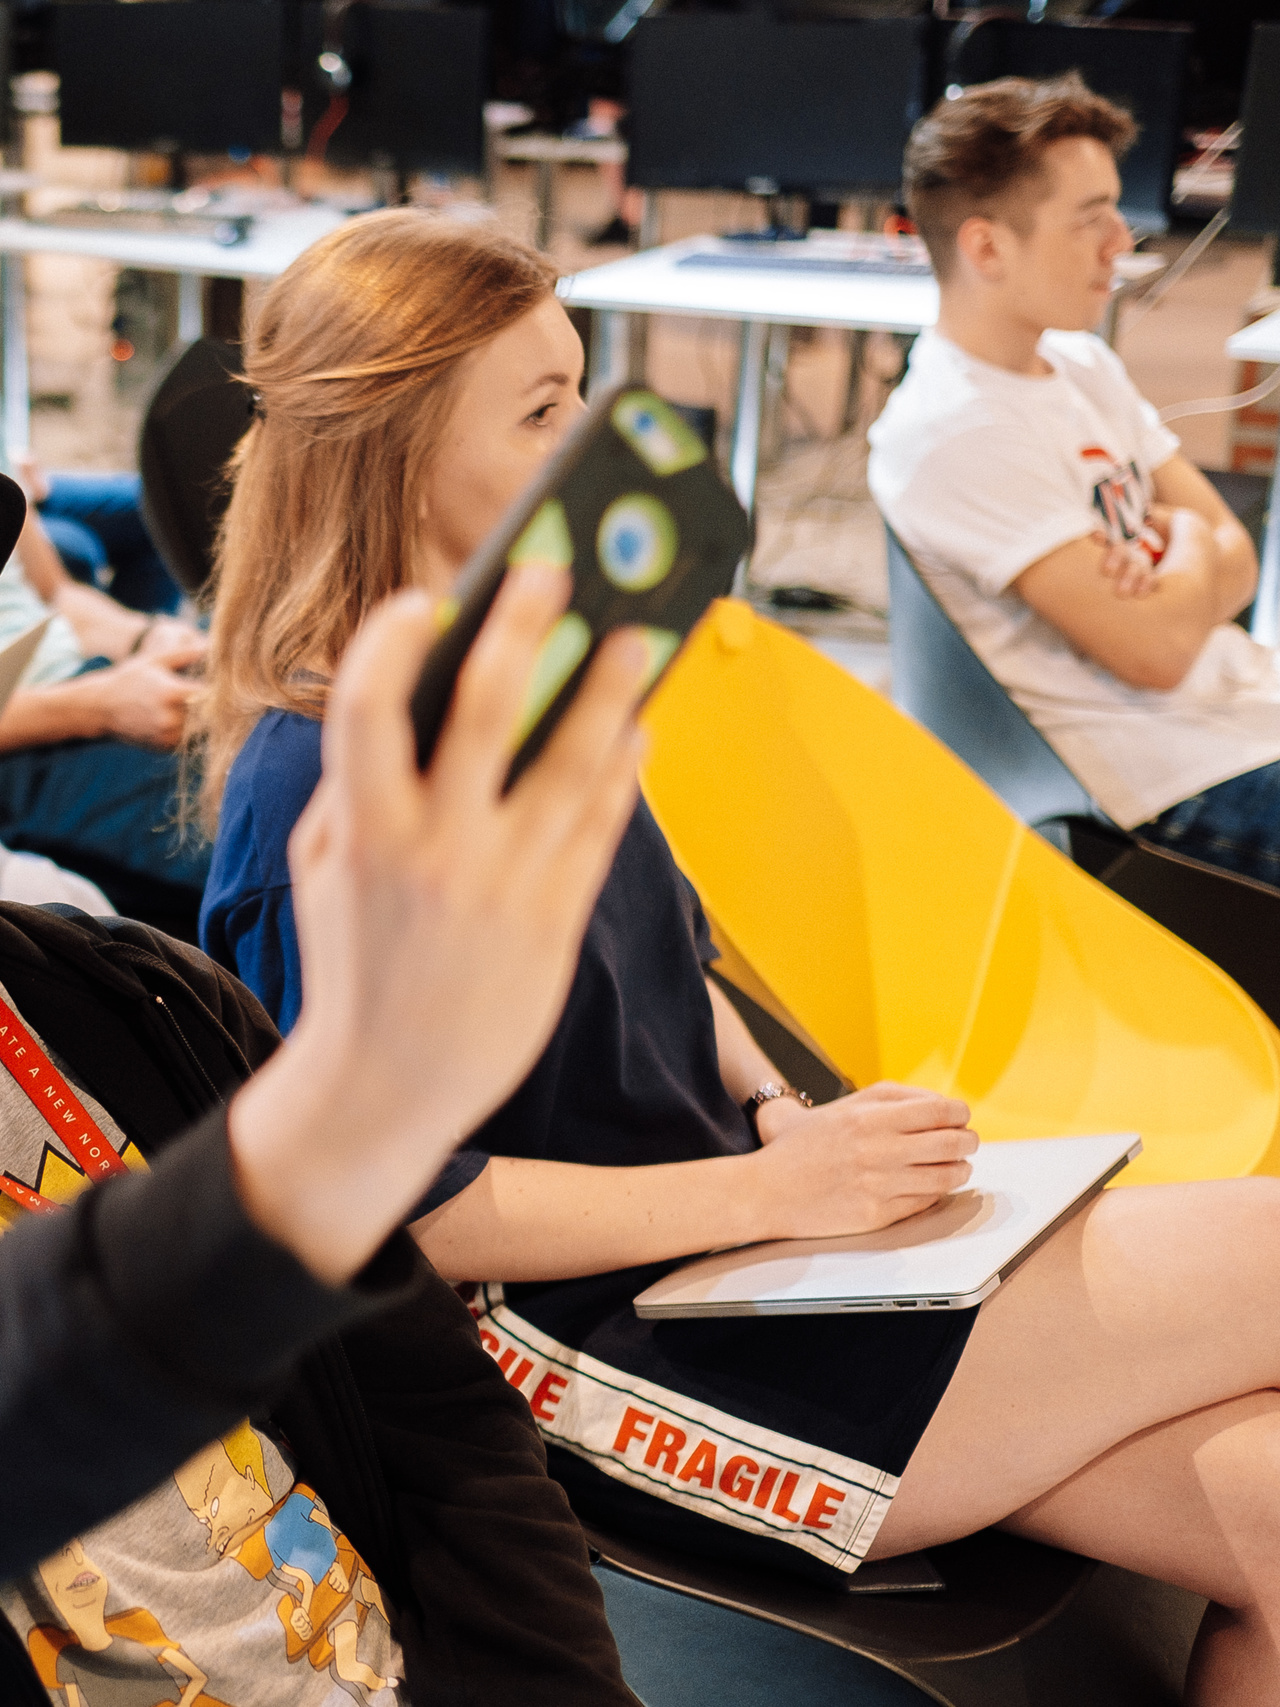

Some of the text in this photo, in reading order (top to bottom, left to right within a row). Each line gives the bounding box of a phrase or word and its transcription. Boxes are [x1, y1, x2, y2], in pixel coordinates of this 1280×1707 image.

[28, 1066, 40, 1079] A
[43, 1085, 77, 1124] NEW
[78, 1132, 117, 1178] NOR
[612, 1406, 847, 1530] FRAGILE
